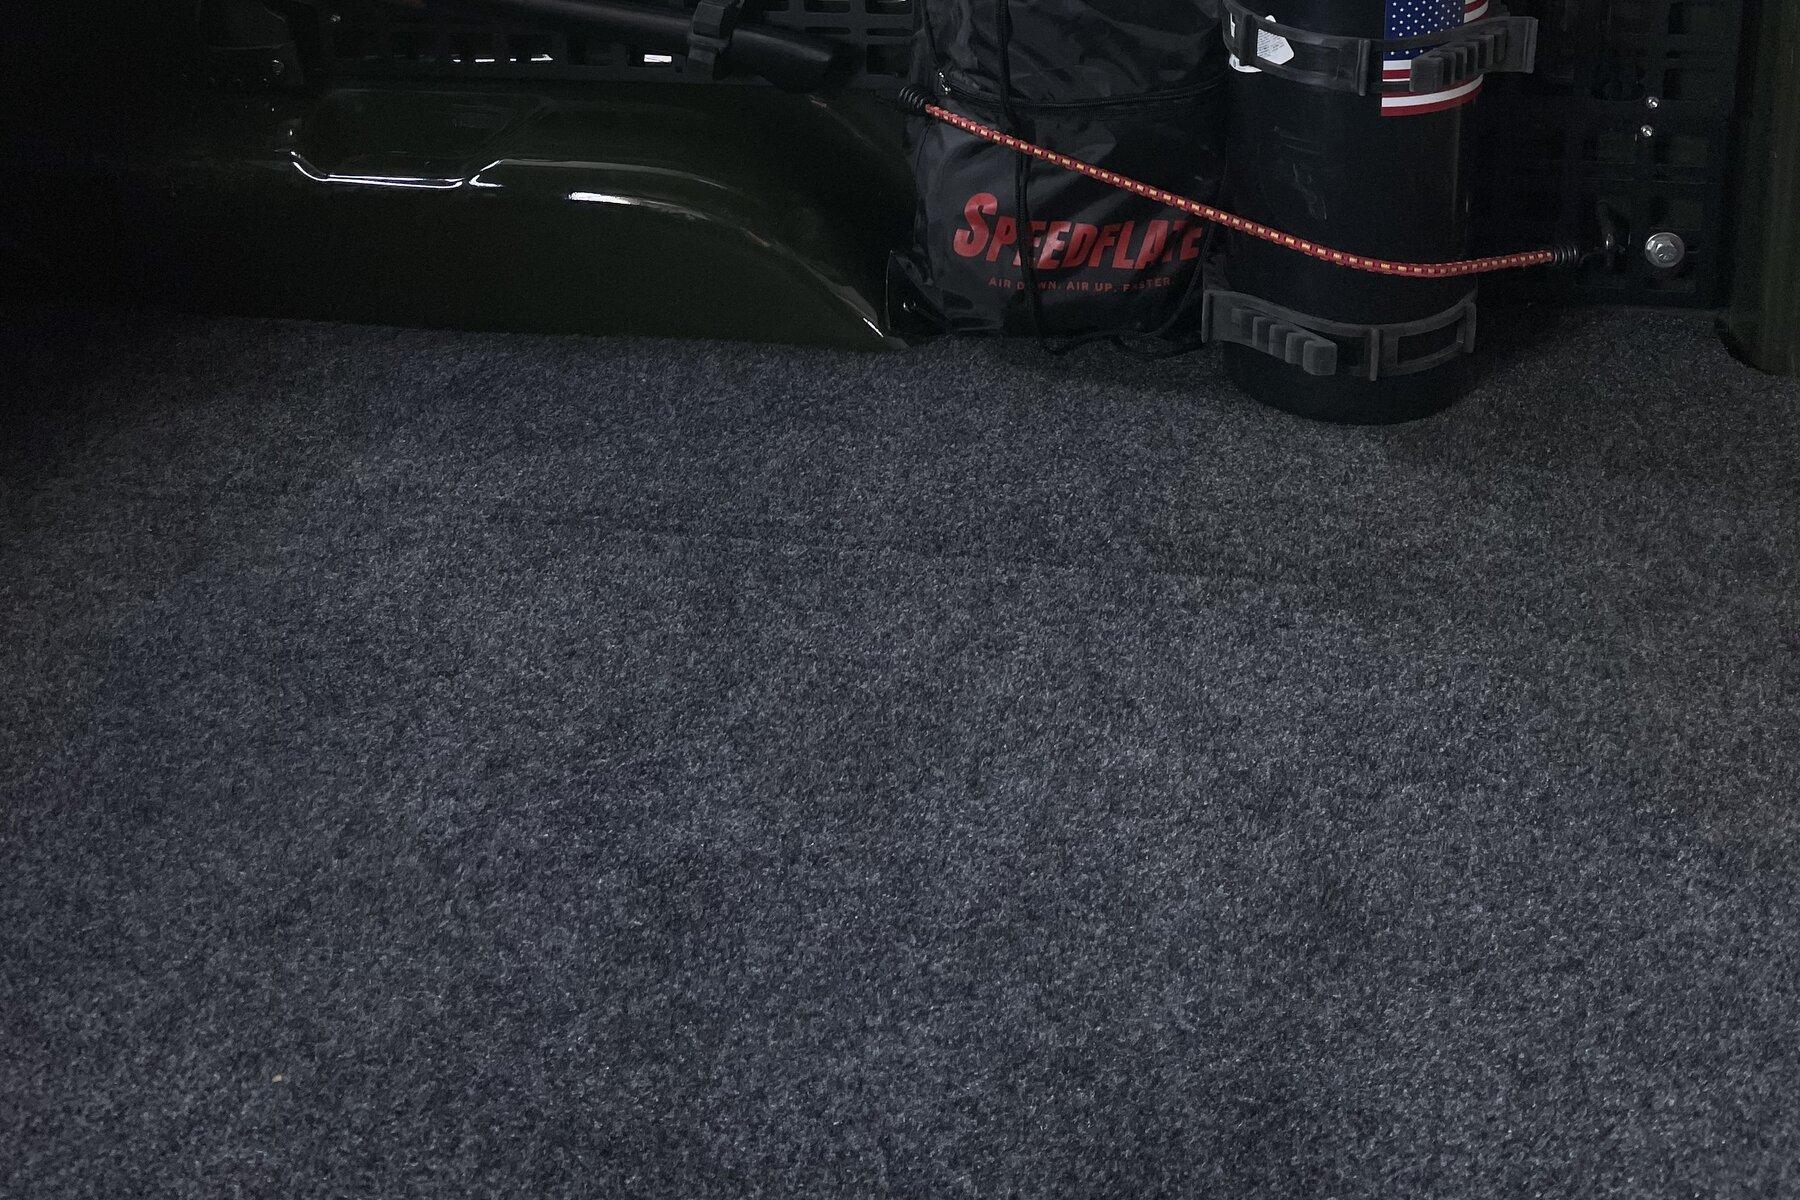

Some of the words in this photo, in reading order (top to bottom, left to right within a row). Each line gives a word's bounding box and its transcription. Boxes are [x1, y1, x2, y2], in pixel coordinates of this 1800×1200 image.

[987, 276, 1012, 289] AIR
[1015, 279, 1062, 291] DWN.
[1065, 280, 1090, 291] AIR
[1121, 276, 1176, 292] FSTER.
